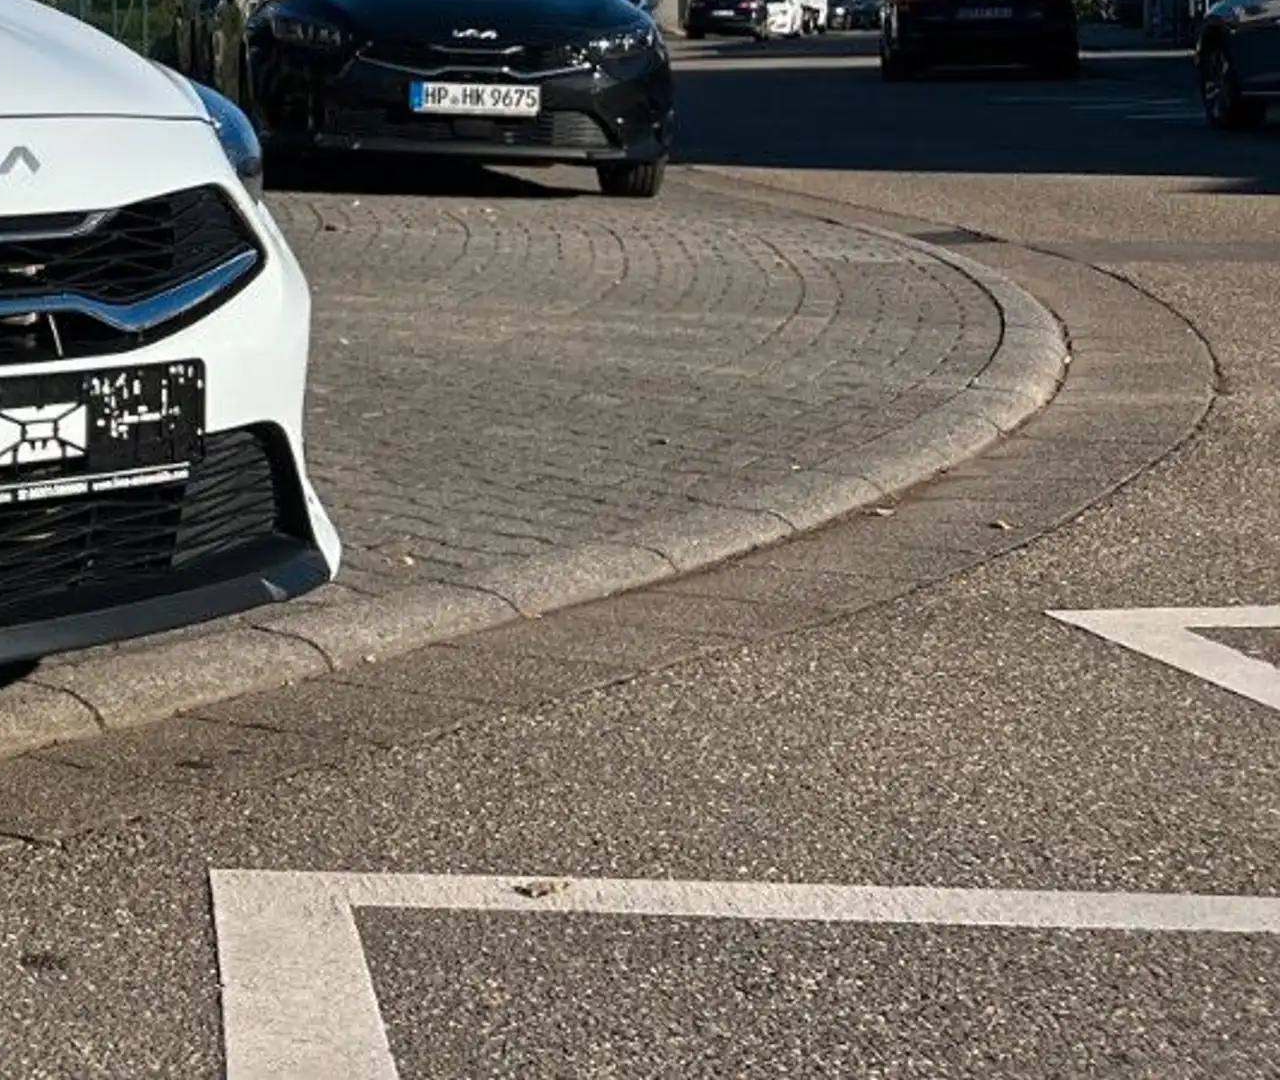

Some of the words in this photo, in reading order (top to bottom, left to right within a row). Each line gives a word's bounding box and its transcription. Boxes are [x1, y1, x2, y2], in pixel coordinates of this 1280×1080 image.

[423, 86, 449, 105] HP
[461, 86, 485, 107] HK
[490, 88, 538, 108] 9675
